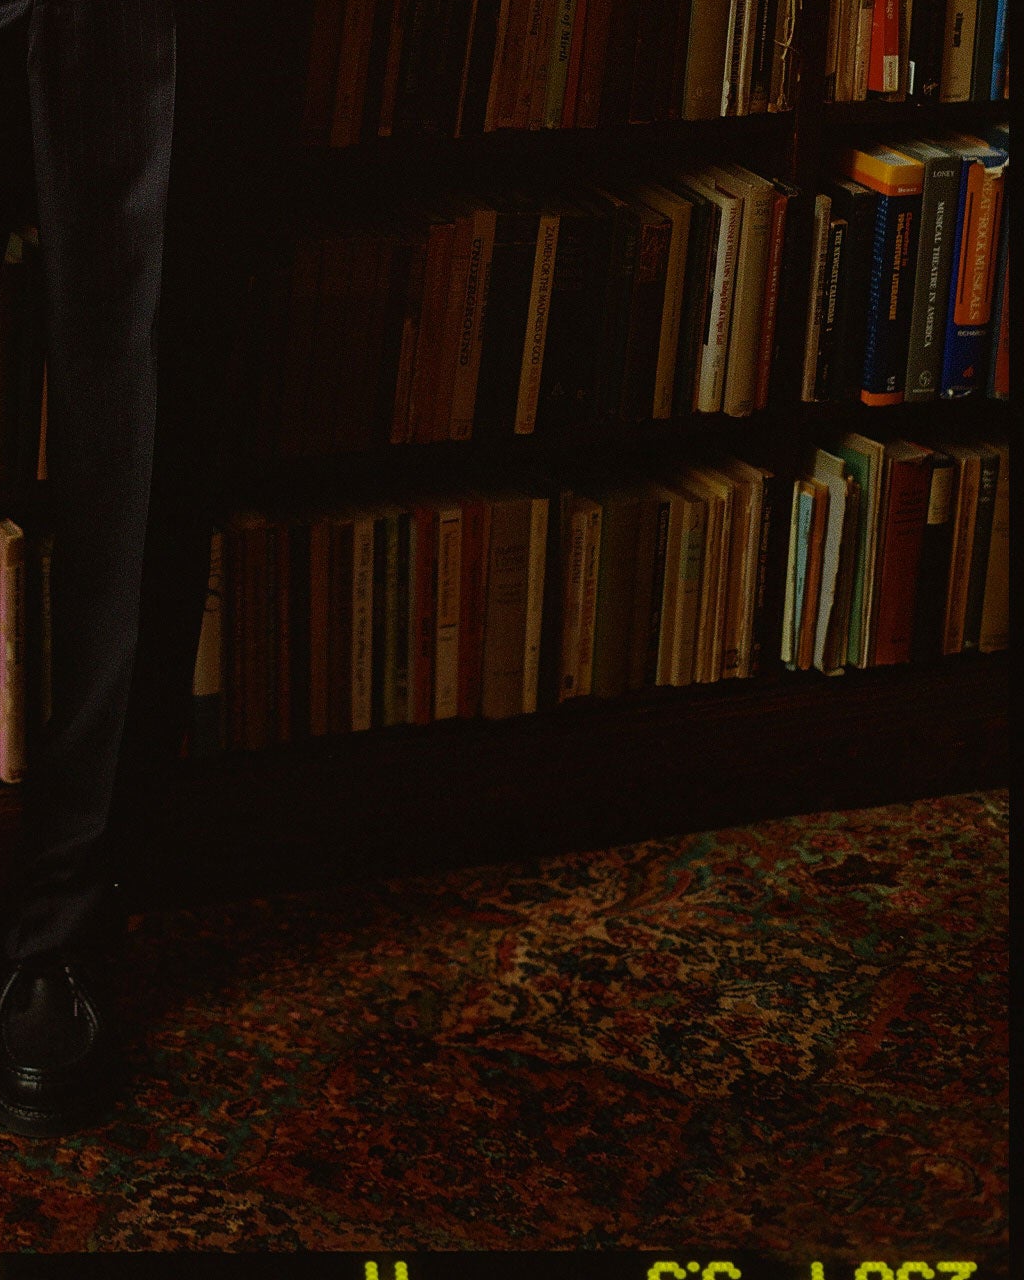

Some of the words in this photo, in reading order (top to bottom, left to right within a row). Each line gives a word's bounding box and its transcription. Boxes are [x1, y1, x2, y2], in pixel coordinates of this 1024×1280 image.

[560, 14, 573, 28] of
[559, 30, 572, 62] Mirth
[933, 200, 945, 244] MUSICAL
[975, 213, 990, 252] ROCK
[540, 268, 548, 283] THE
[541, 255, 549, 265] OR
[928, 245, 942, 290] THEATRE
[888, 272, 900, 321] LITERATURE
[927, 291, 936, 303] IN
[968, 255, 986, 320] MUSICALS
[923, 305, 936, 348] AMERICA
